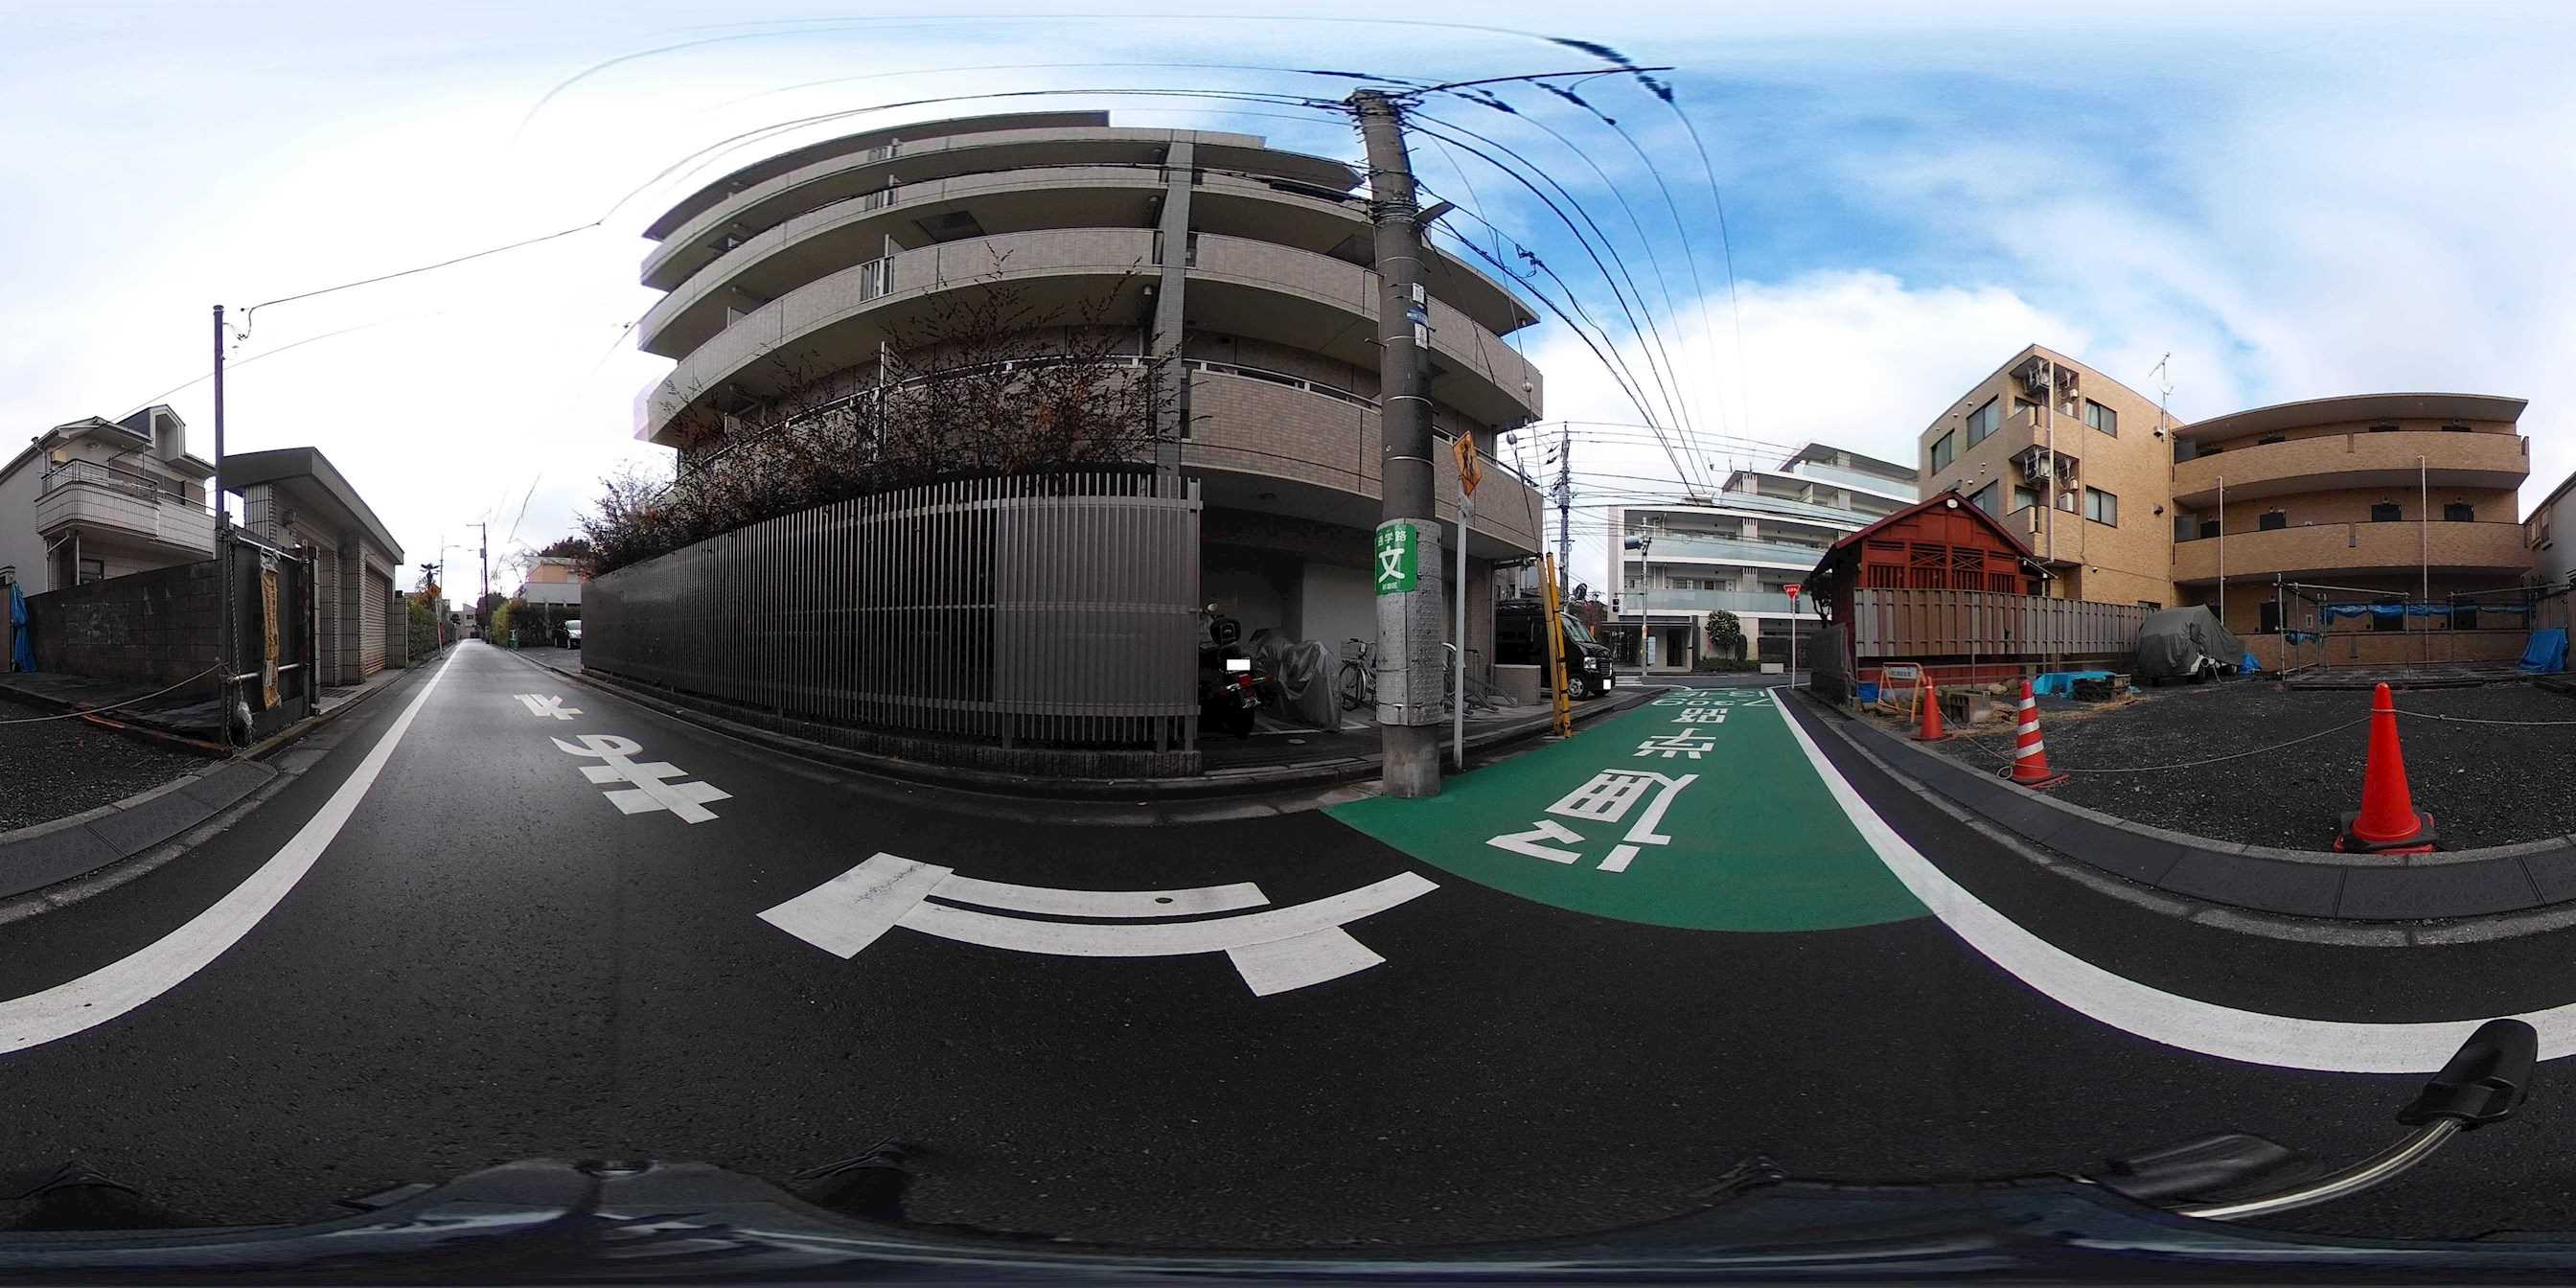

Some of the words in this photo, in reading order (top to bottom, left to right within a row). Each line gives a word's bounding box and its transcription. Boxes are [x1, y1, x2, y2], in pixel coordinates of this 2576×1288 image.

[1378, 545, 1406, 583] 文
[1485, 707, 1728, 873] 通学路
